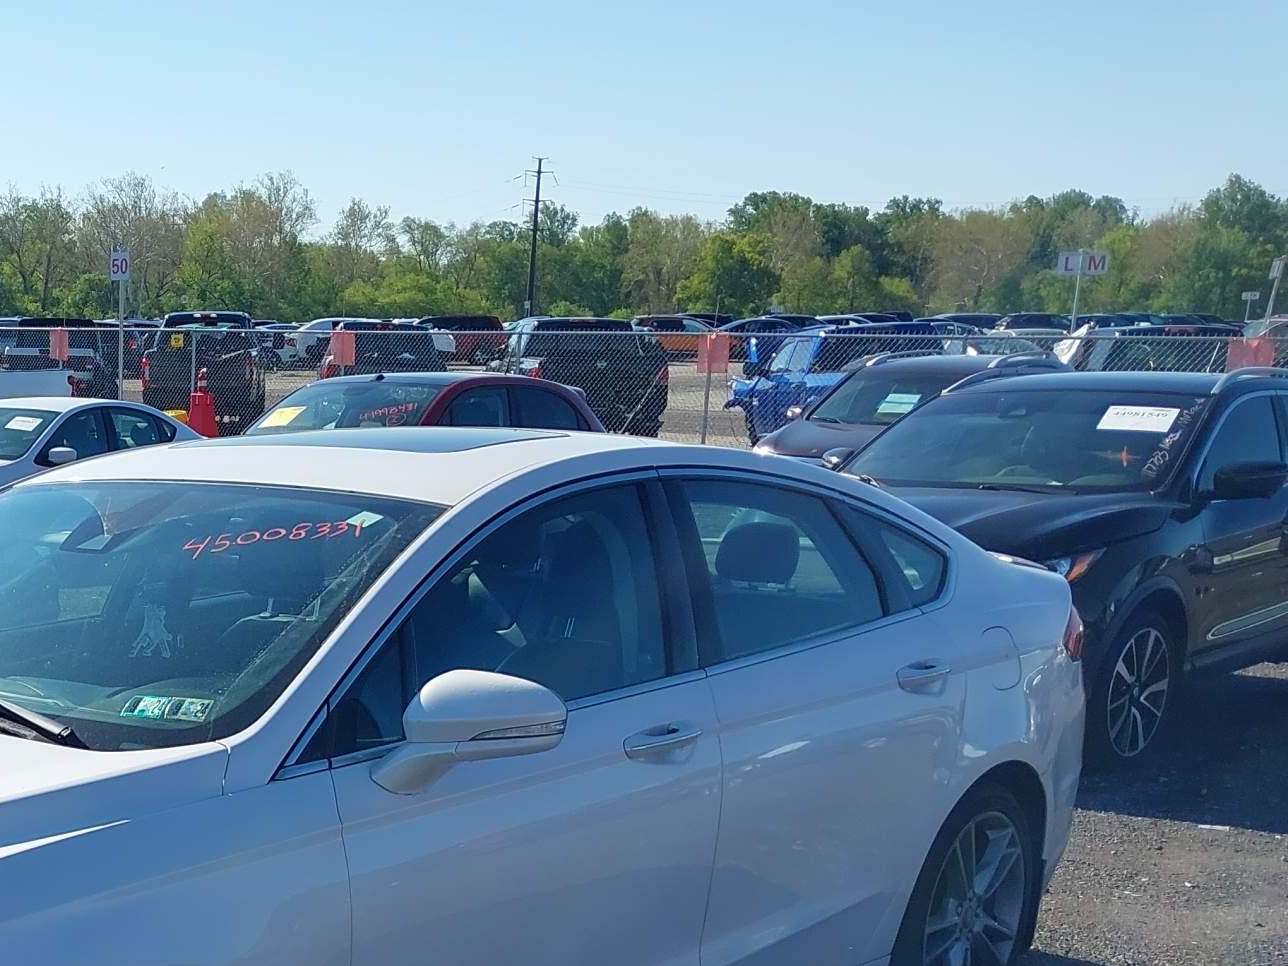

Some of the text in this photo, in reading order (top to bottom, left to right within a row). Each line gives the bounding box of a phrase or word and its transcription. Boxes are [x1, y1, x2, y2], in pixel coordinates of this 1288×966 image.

[112, 258, 128, 274] 50
[1064, 255, 1106, 271] L M
[183, 518, 365, 560] 45008331
[193, 702, 210, 717] 24
